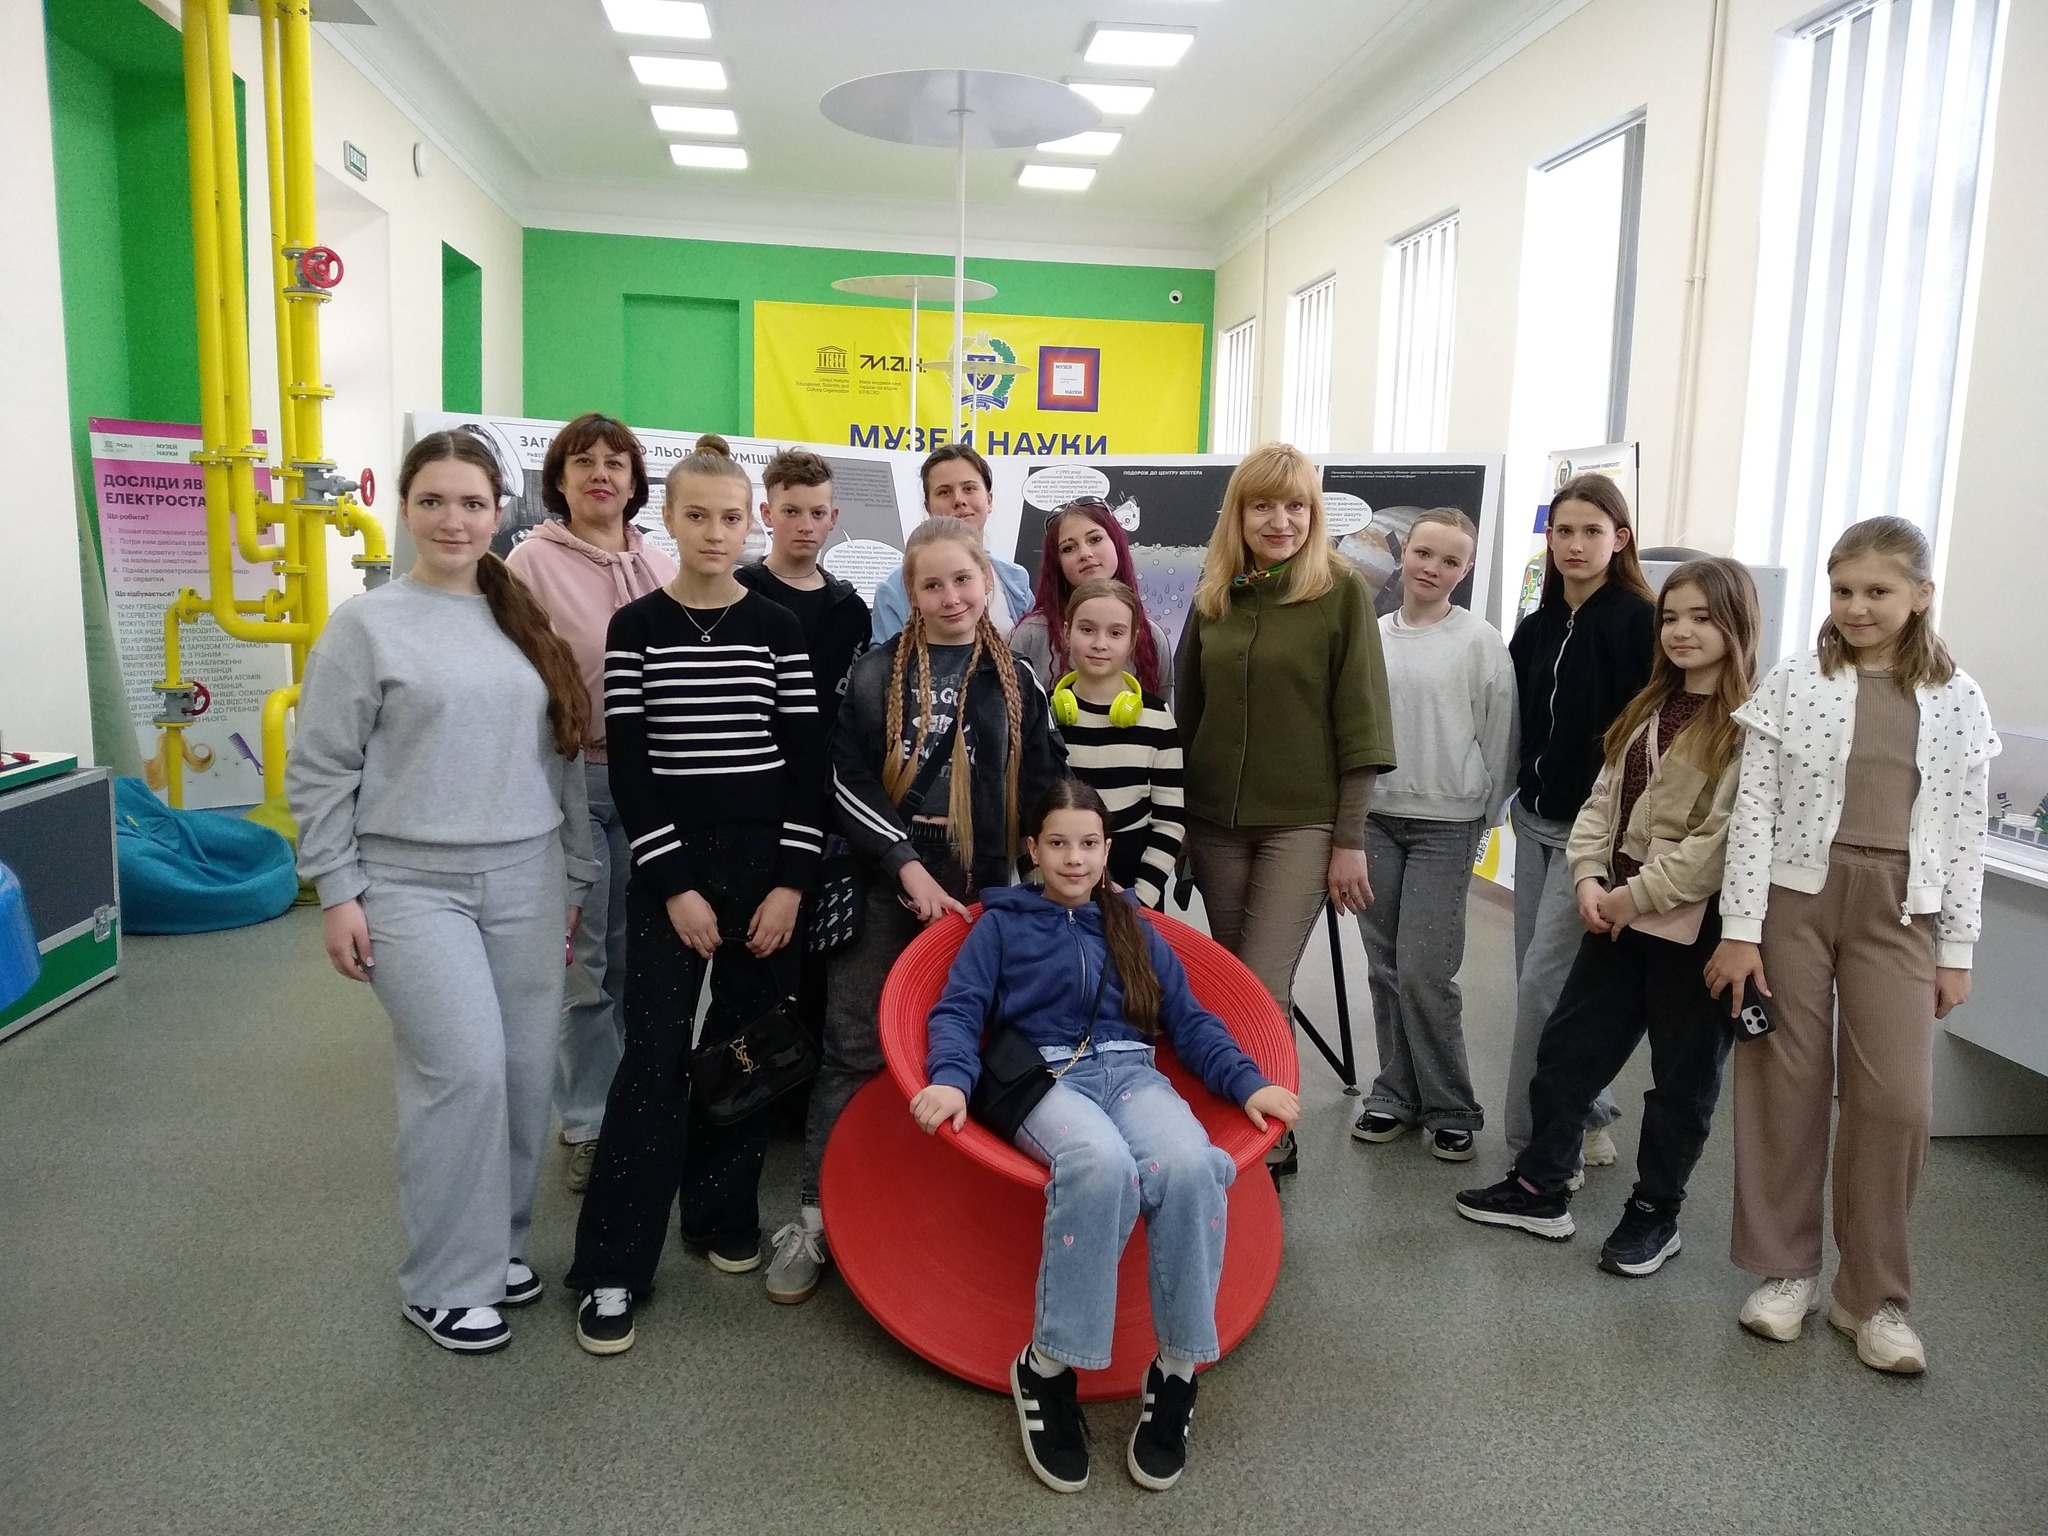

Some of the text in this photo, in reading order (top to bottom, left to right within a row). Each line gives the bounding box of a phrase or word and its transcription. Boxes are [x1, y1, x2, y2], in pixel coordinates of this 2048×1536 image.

[850, 422, 1107, 456] МУЗЕЙ НАУКИ
[103, 473, 204, 490] ДОСЛІДИ ЯВ
[105, 492, 207, 507] ЕЛЕКТРОСТА
[120, 513, 149, 521] робити?
[127, 590, 175, 598] відбувається?
